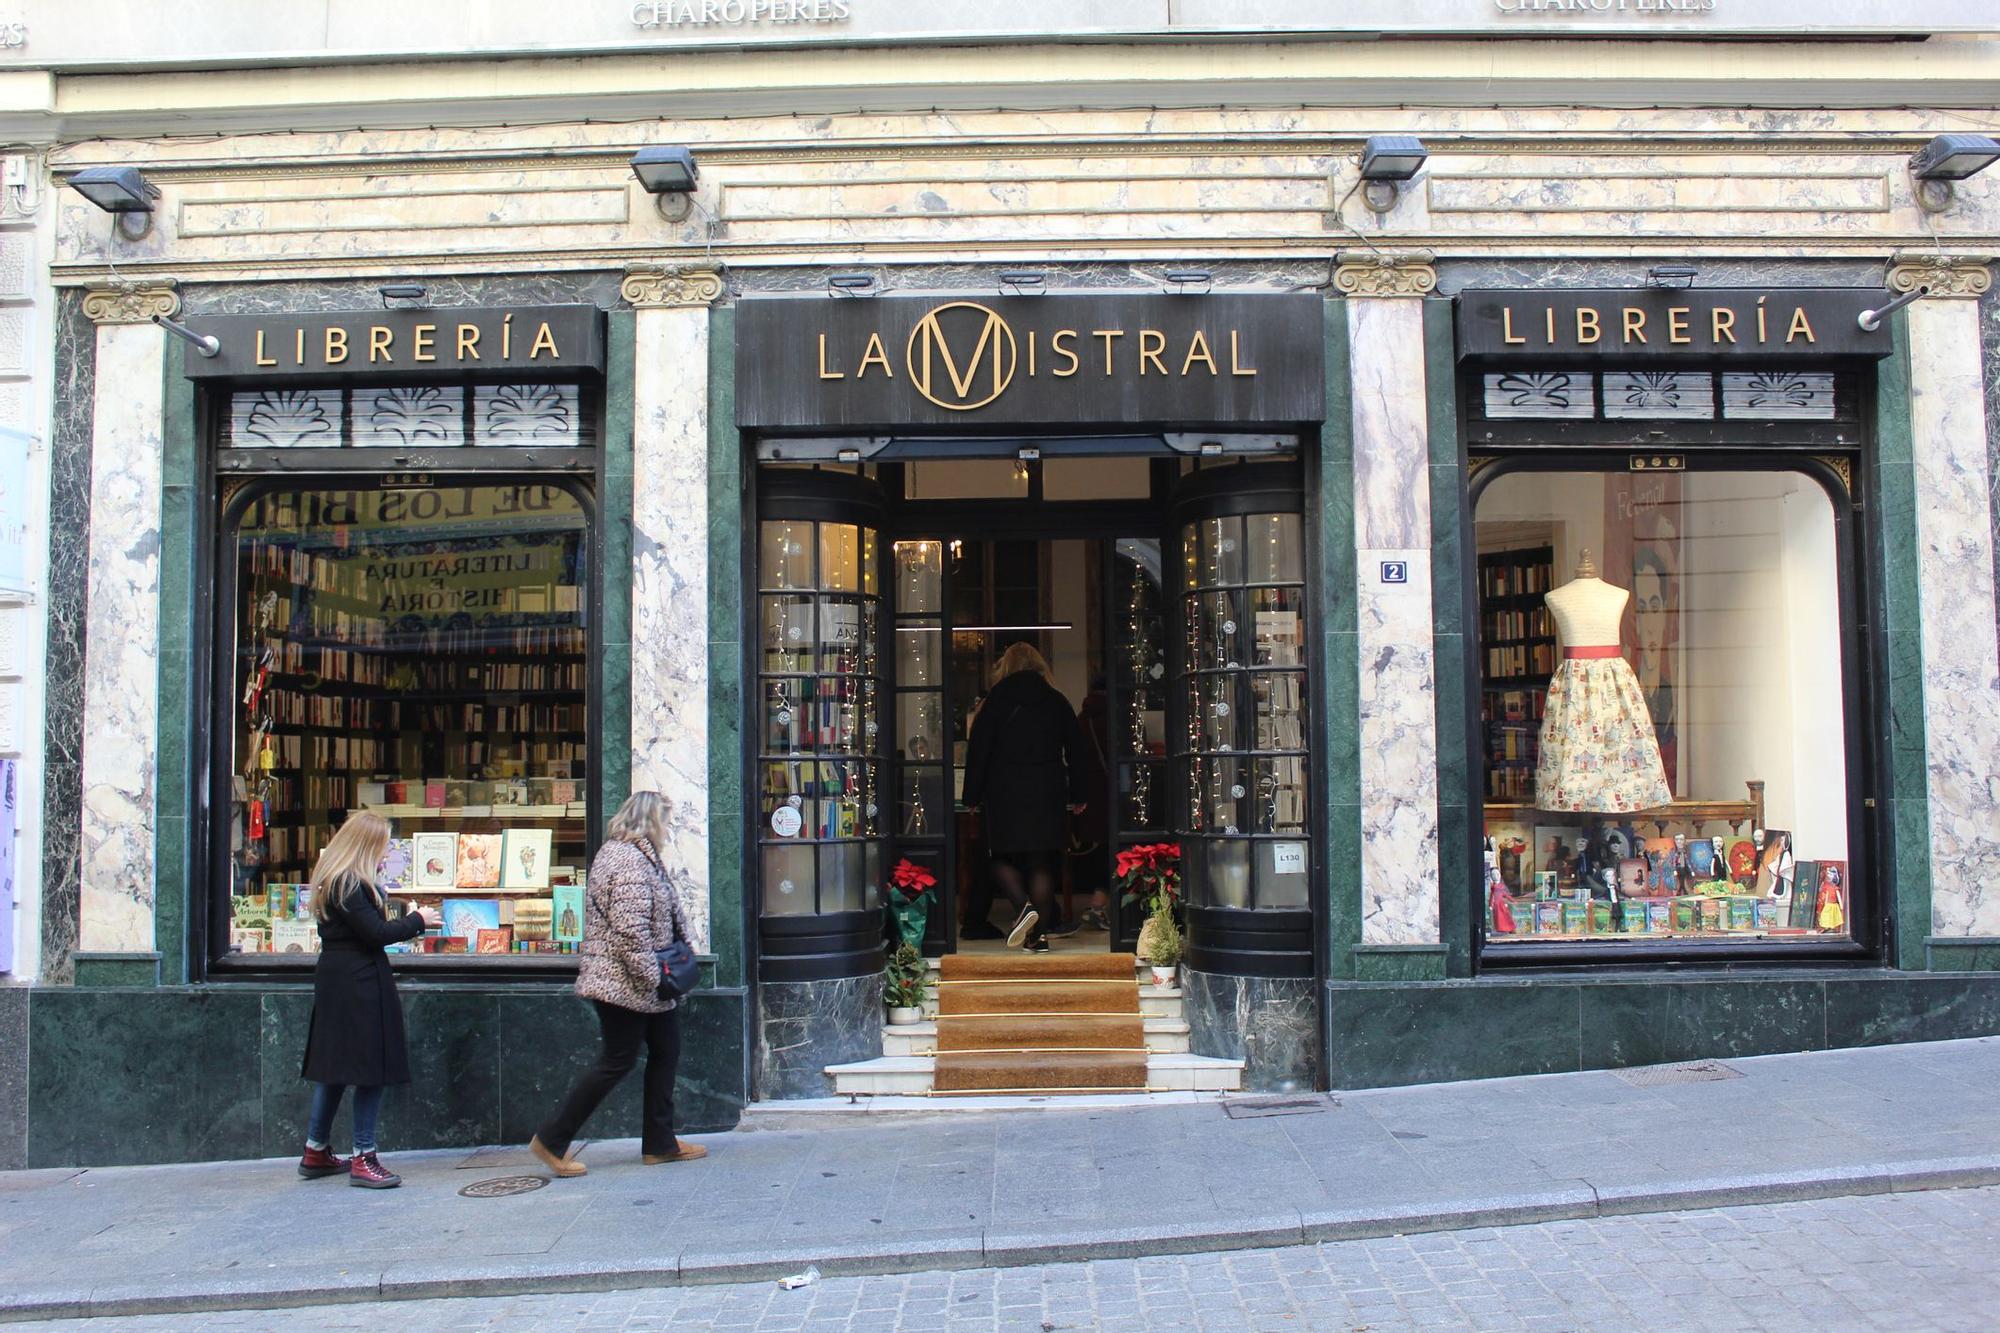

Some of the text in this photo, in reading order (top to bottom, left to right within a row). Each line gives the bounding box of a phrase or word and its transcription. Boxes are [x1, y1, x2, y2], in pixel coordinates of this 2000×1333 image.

[256, 313, 560, 366] LIBRERÍA
[1502, 296, 1817, 345] LIBRERÍA
[818, 331, 893, 379] LA
